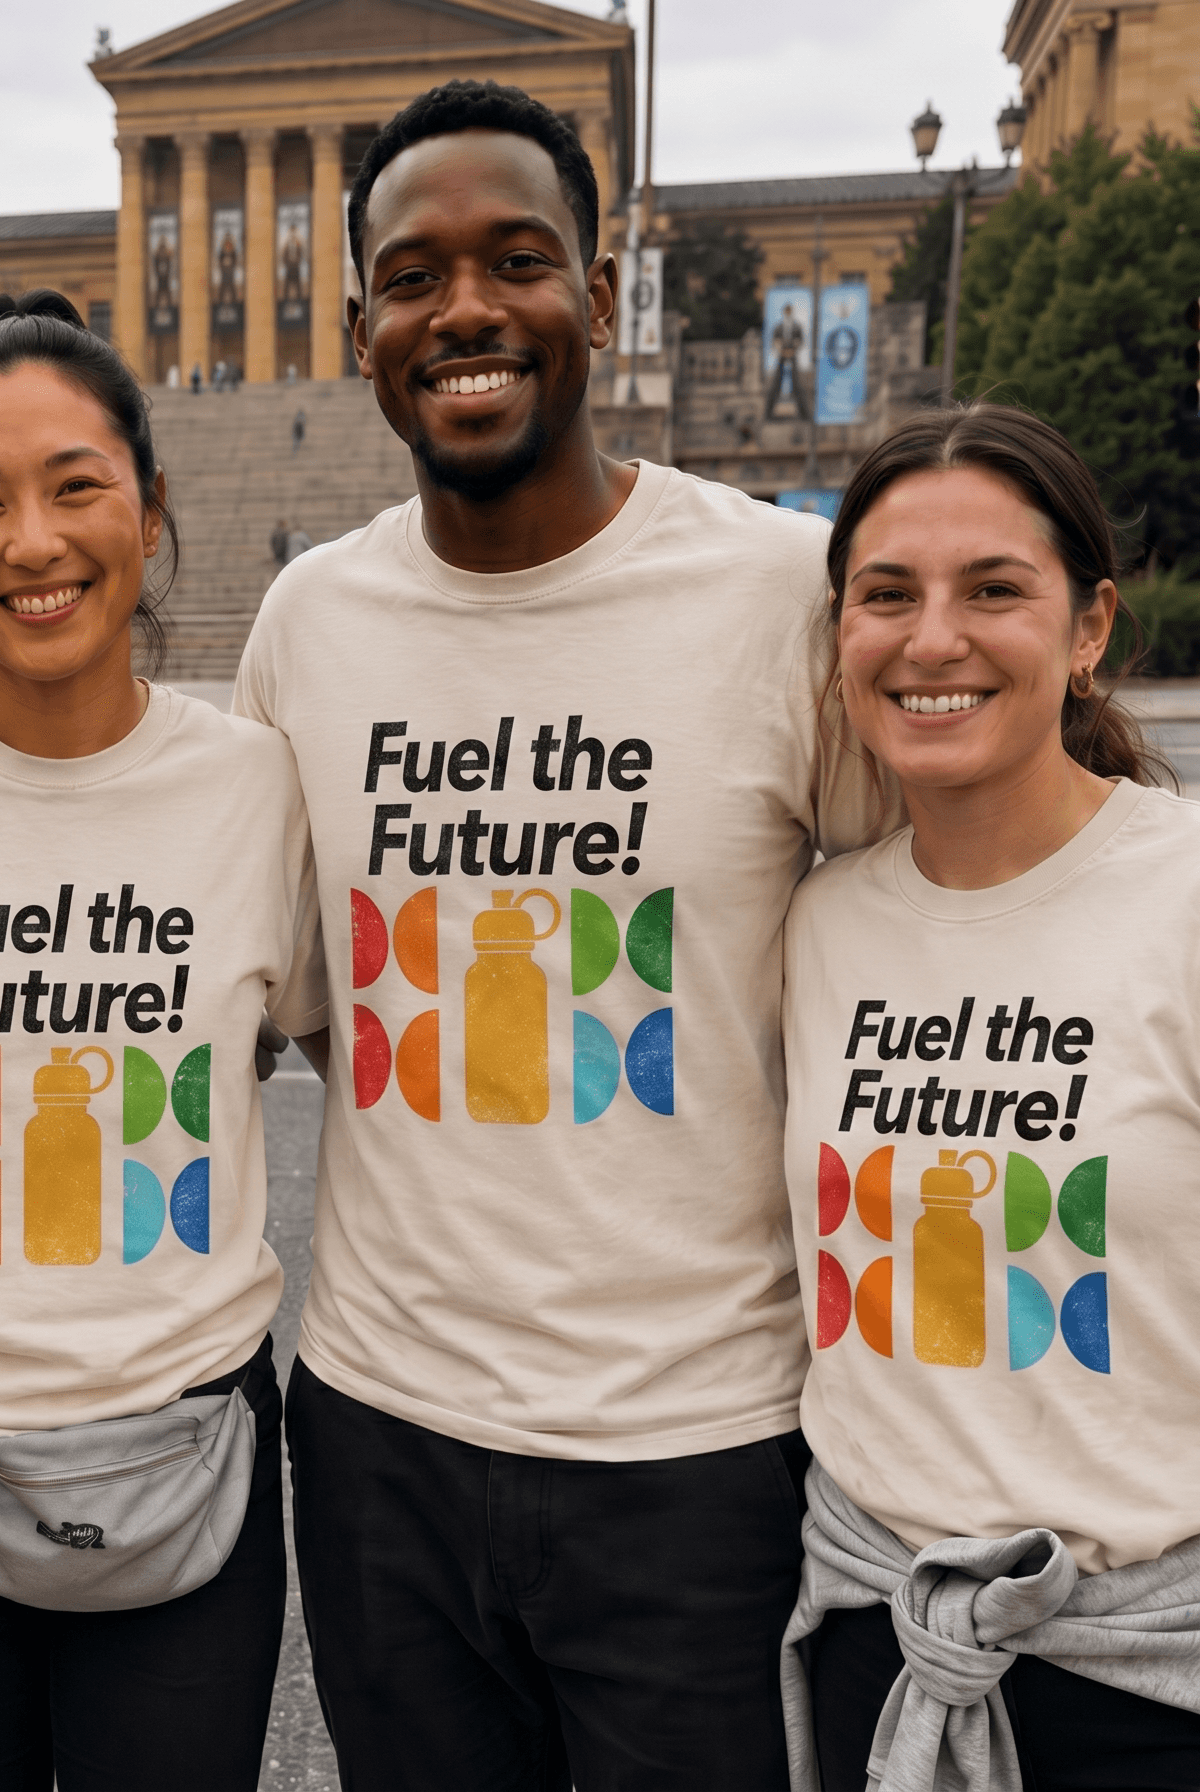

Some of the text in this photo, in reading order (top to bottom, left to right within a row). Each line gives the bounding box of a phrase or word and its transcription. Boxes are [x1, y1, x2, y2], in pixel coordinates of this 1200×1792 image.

[364, 715, 652, 793] Fuel the
[368, 802, 648, 876] Future!
[88, 884, 193, 954] the
[845, 997, 1093, 1065] Fuel the
[839, 1069, 1087, 1141] Future!
